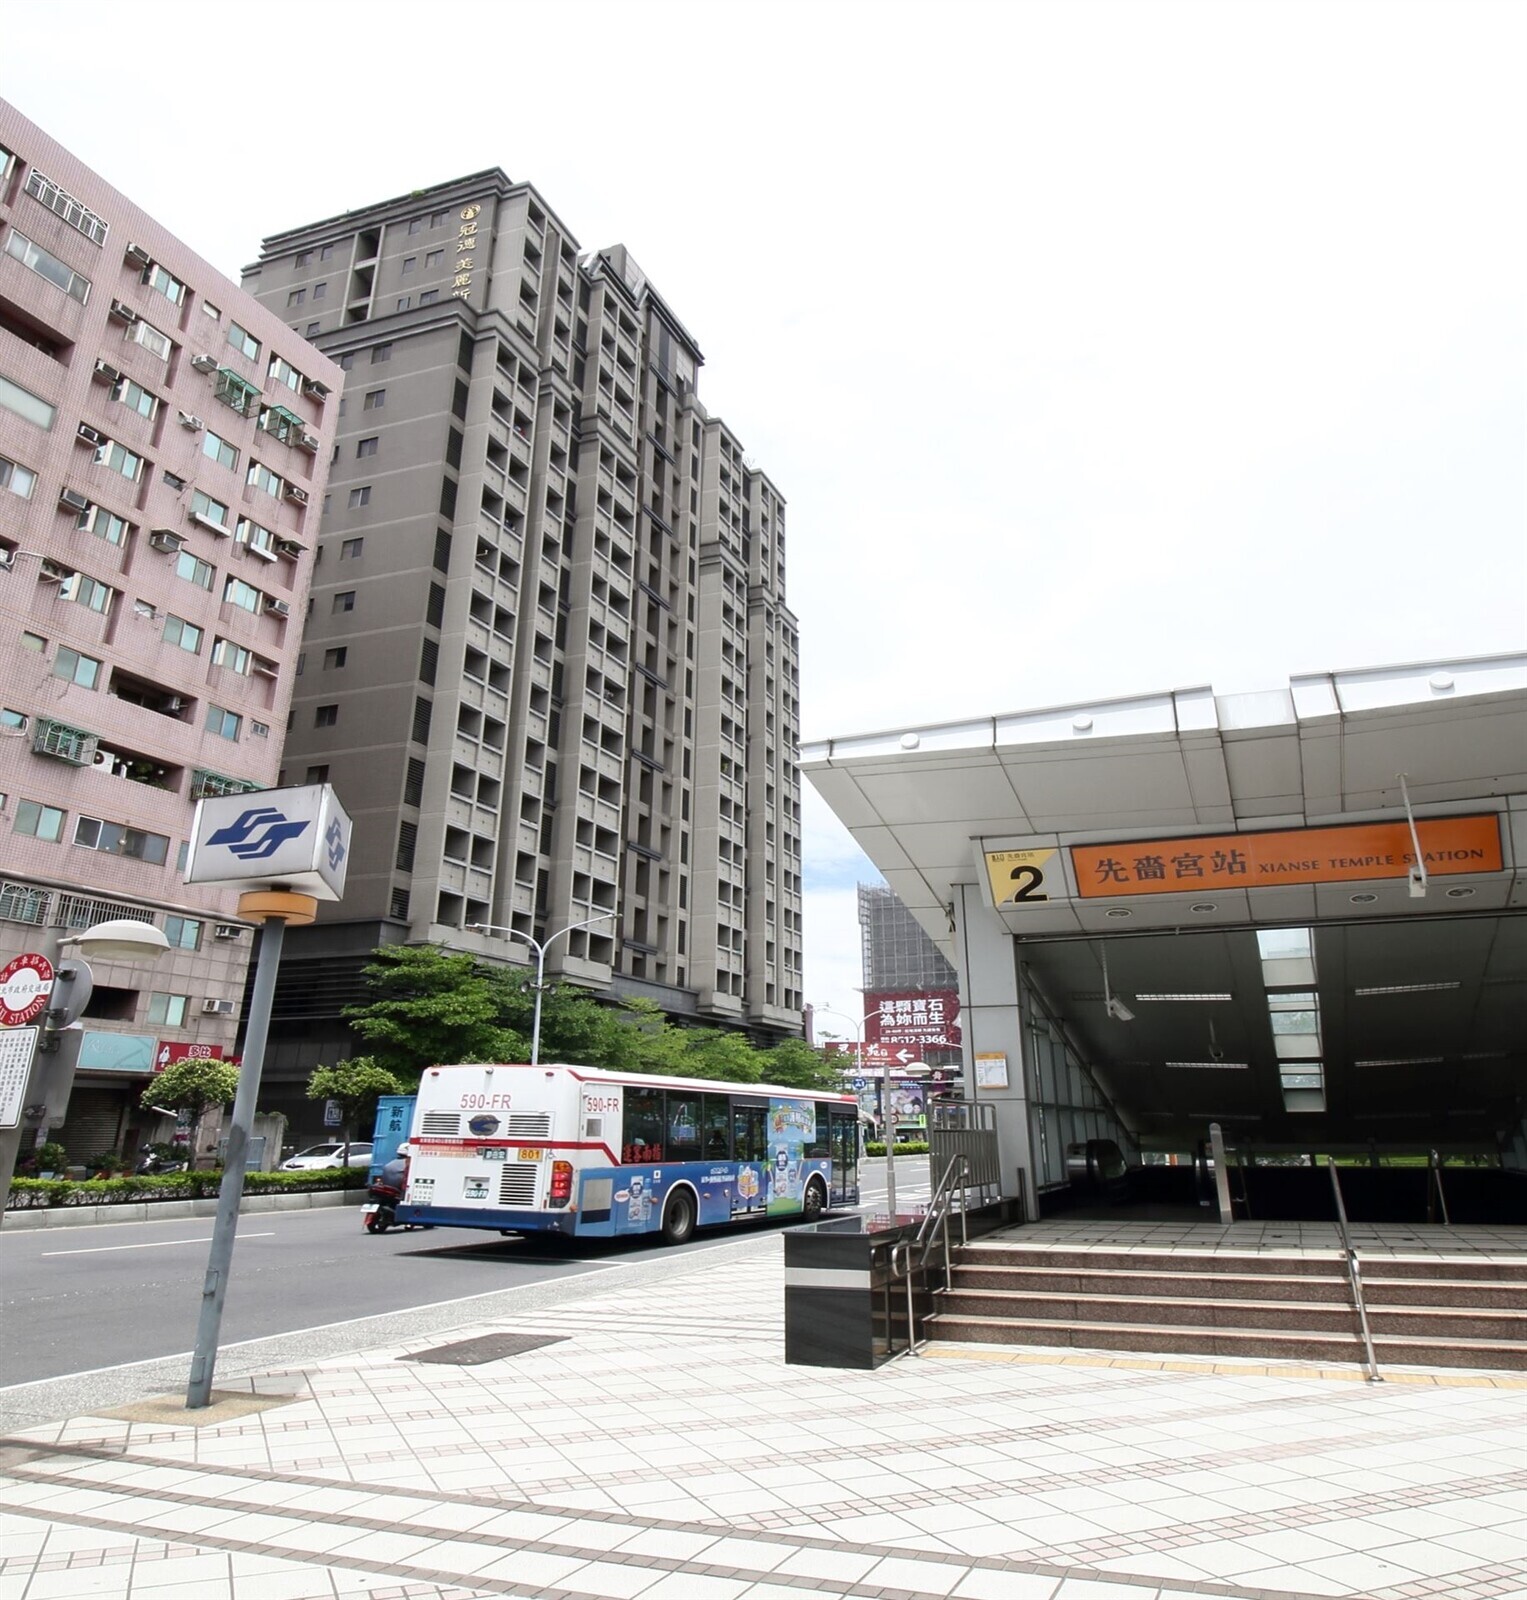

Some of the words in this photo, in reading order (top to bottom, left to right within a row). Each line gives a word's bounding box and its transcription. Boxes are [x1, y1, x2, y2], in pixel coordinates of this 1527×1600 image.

[1094, 849, 1247, 884] 先嗇宮站
[1259, 859, 1320, 874] XIANSE
[1329, 853, 1394, 870] TEMPLE
[1402, 848, 1484, 864] STATION
[1010, 865, 1048, 902] 2
[8, 996, 45, 1024] STATION
[879, 998, 944, 1013] 這顆寶石
[880, 1011, 945, 1026] 為妳而生
[460, 1094, 512, 1109] 590-FR
[587, 1097, 619, 1112] 590-FR
[389, 1105, 404, 1132] 新航
[521, 1149, 540, 1159] 801
